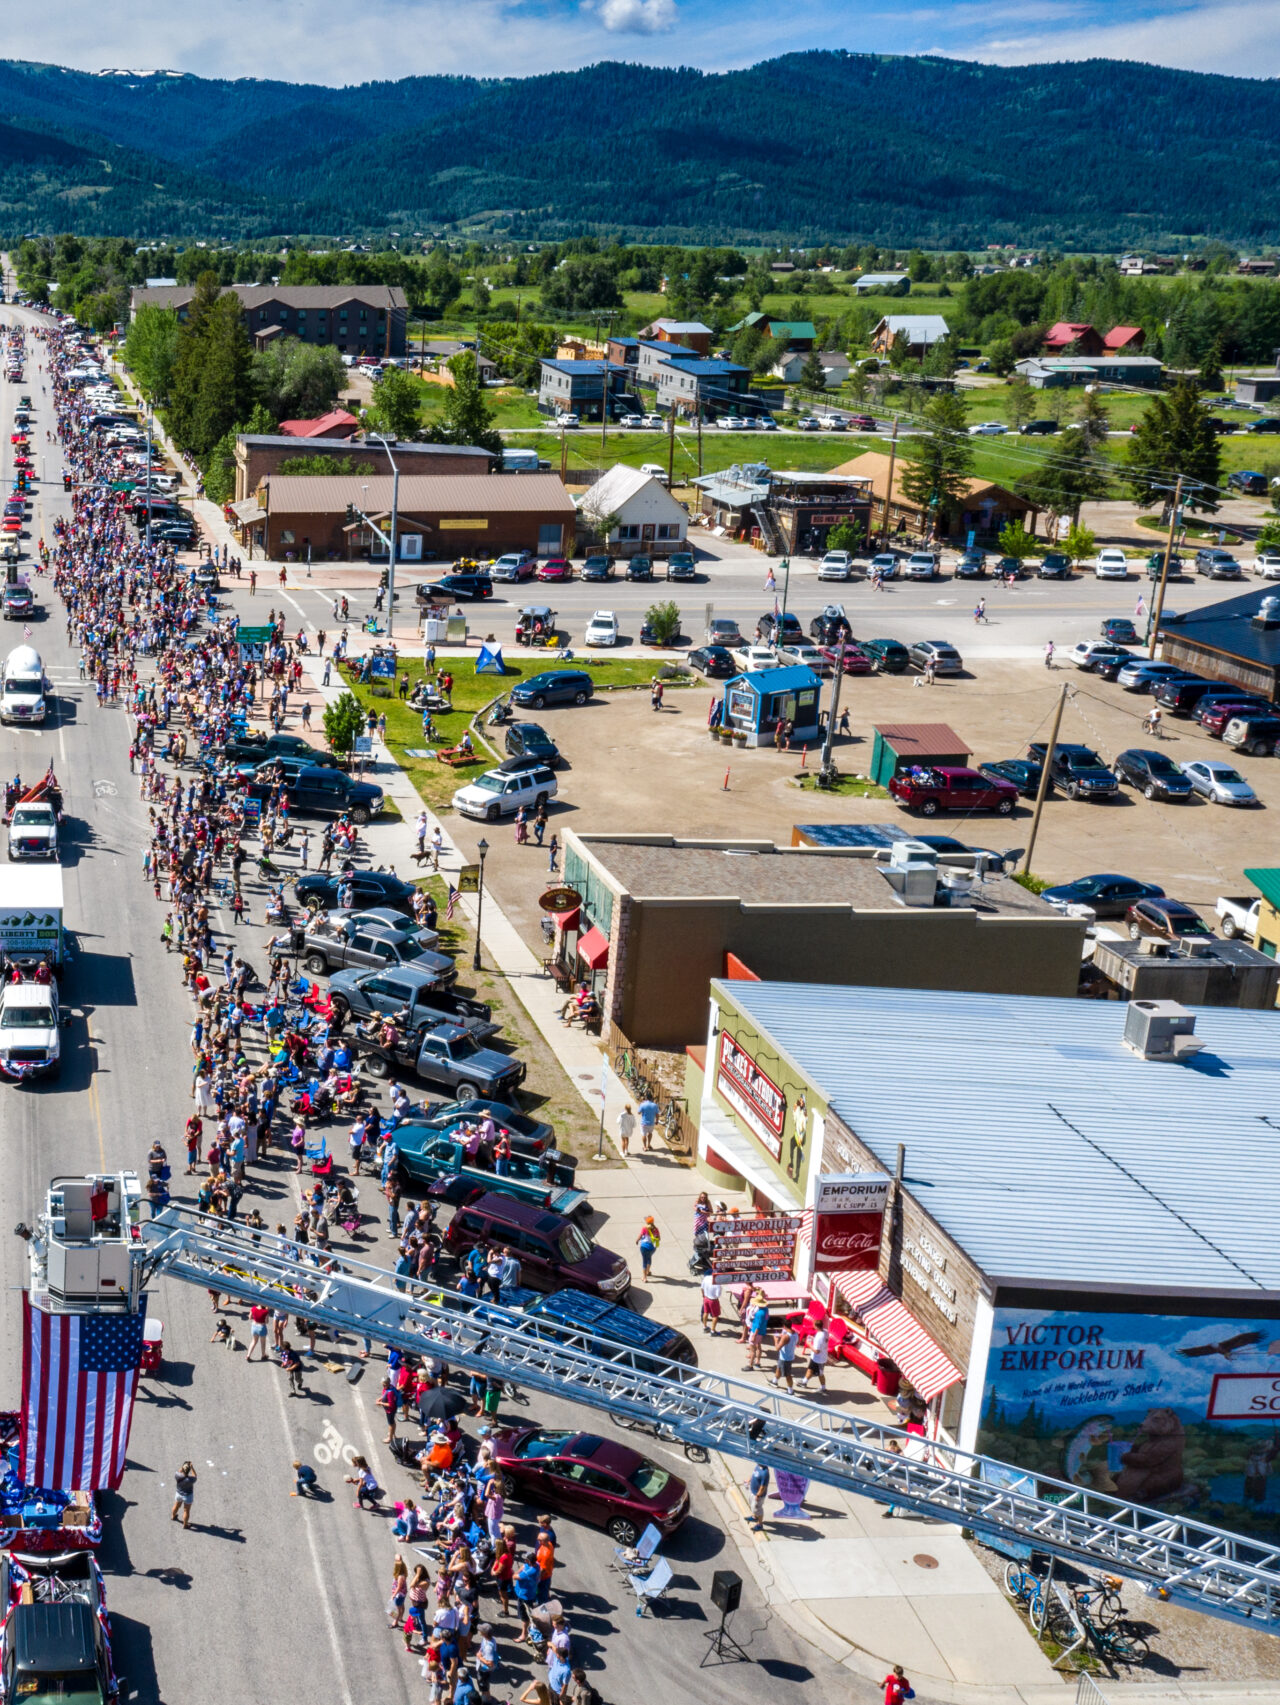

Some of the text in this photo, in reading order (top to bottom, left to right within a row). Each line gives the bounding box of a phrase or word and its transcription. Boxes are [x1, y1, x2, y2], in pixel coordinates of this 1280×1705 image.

[823, 1185, 887, 1196] EMPORIUM
[734, 1218, 791, 1231] EMPORIUM
[750, 1235, 787, 1243] FOUNTAIN
[720, 1249, 756, 1257] SPORTING
[732, 1272, 785, 1281] FLY SHOP
[1005, 1322, 1104, 1347] VICTOR
[1000, 1349, 1146, 1371] EMPORIUM
[1022, 1378, 1113, 1399] Home of the World Famous
[1060, 1387, 1120, 1407] Huckleberry
